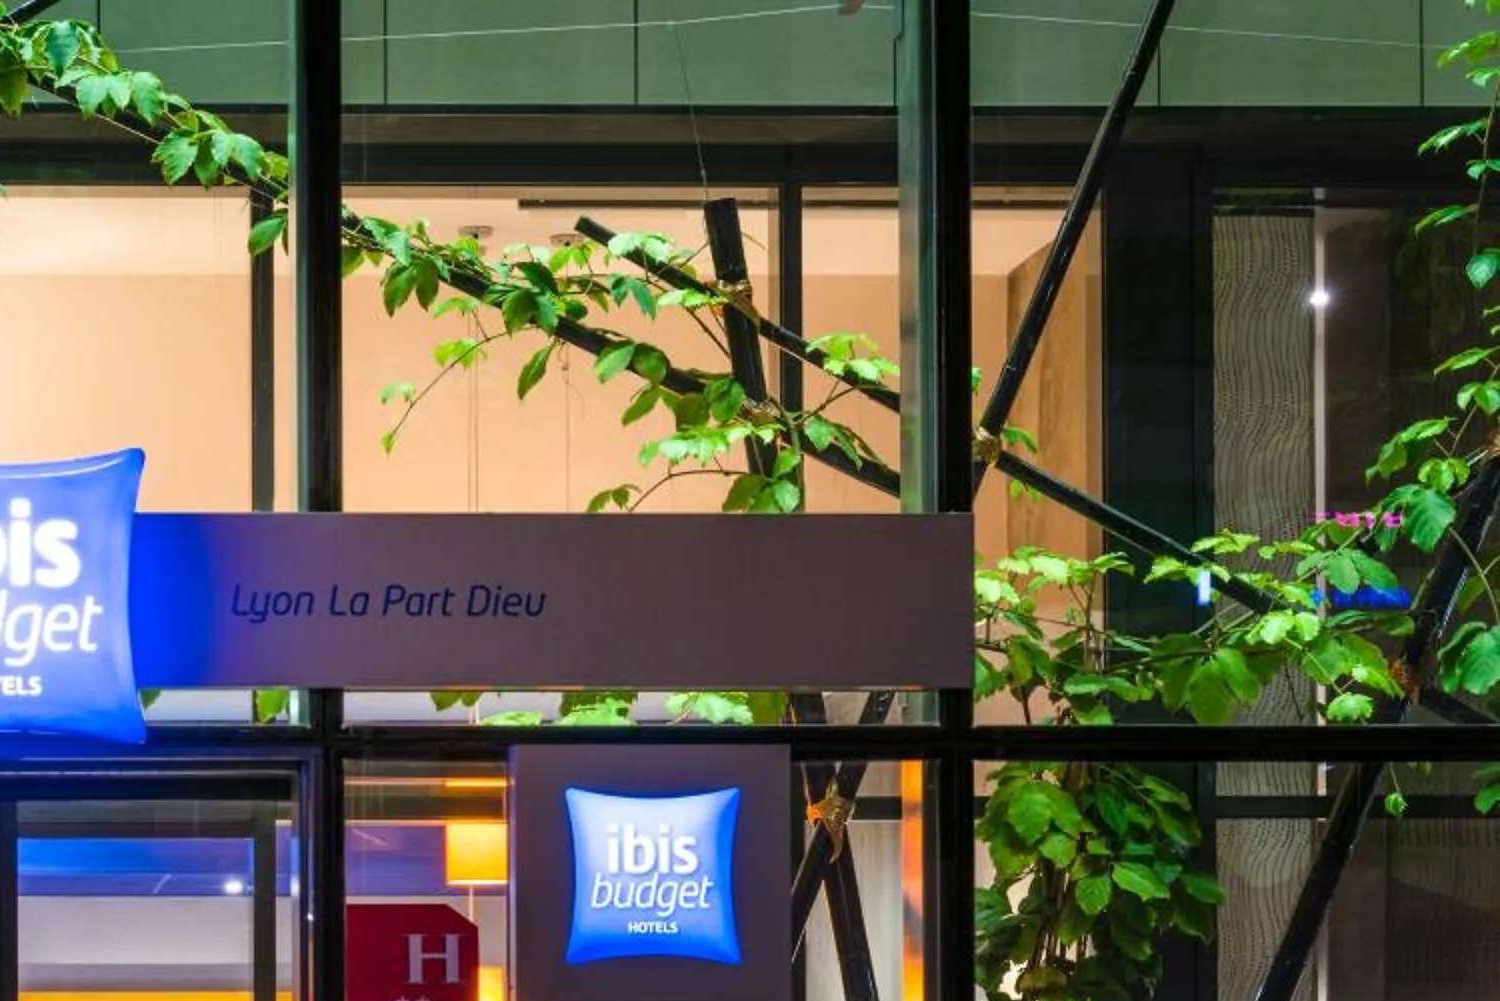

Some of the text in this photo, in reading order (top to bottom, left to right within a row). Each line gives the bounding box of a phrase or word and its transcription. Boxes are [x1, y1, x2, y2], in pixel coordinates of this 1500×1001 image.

[231, 584, 547, 623] Lyon La Part Dieu
[606, 823, 699, 874] ibis
[590, 873, 715, 917] budget
[627, 921, 679, 934] HOTELS
[403, 933, 466, 985] H
